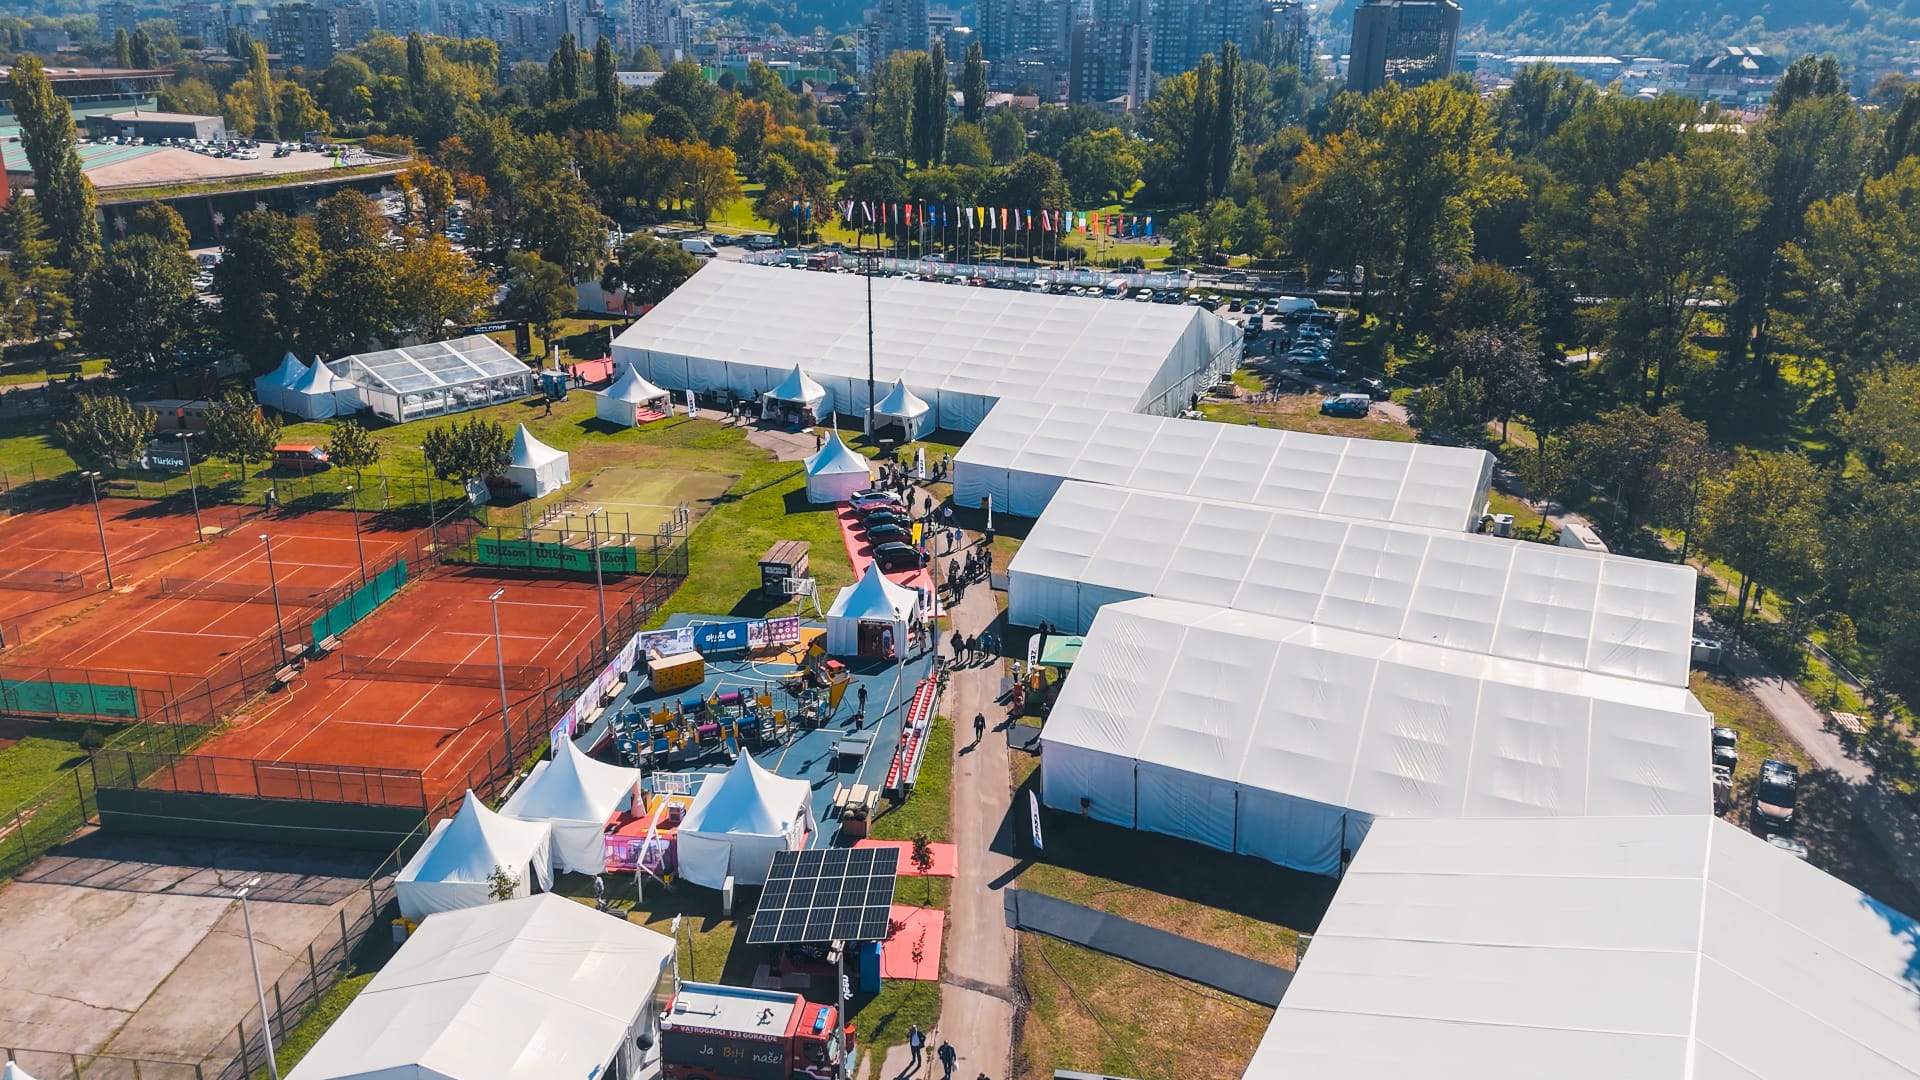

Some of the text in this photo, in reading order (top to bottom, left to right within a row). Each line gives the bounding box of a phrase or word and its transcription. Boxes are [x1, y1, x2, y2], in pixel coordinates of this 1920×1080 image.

[152, 457, 184, 467] Türkiye
[486, 545, 526, 557] Wilson
[535, 547, 576, 561] Wilson
[700, 1044, 783, 1064] Ja BiH naše!
